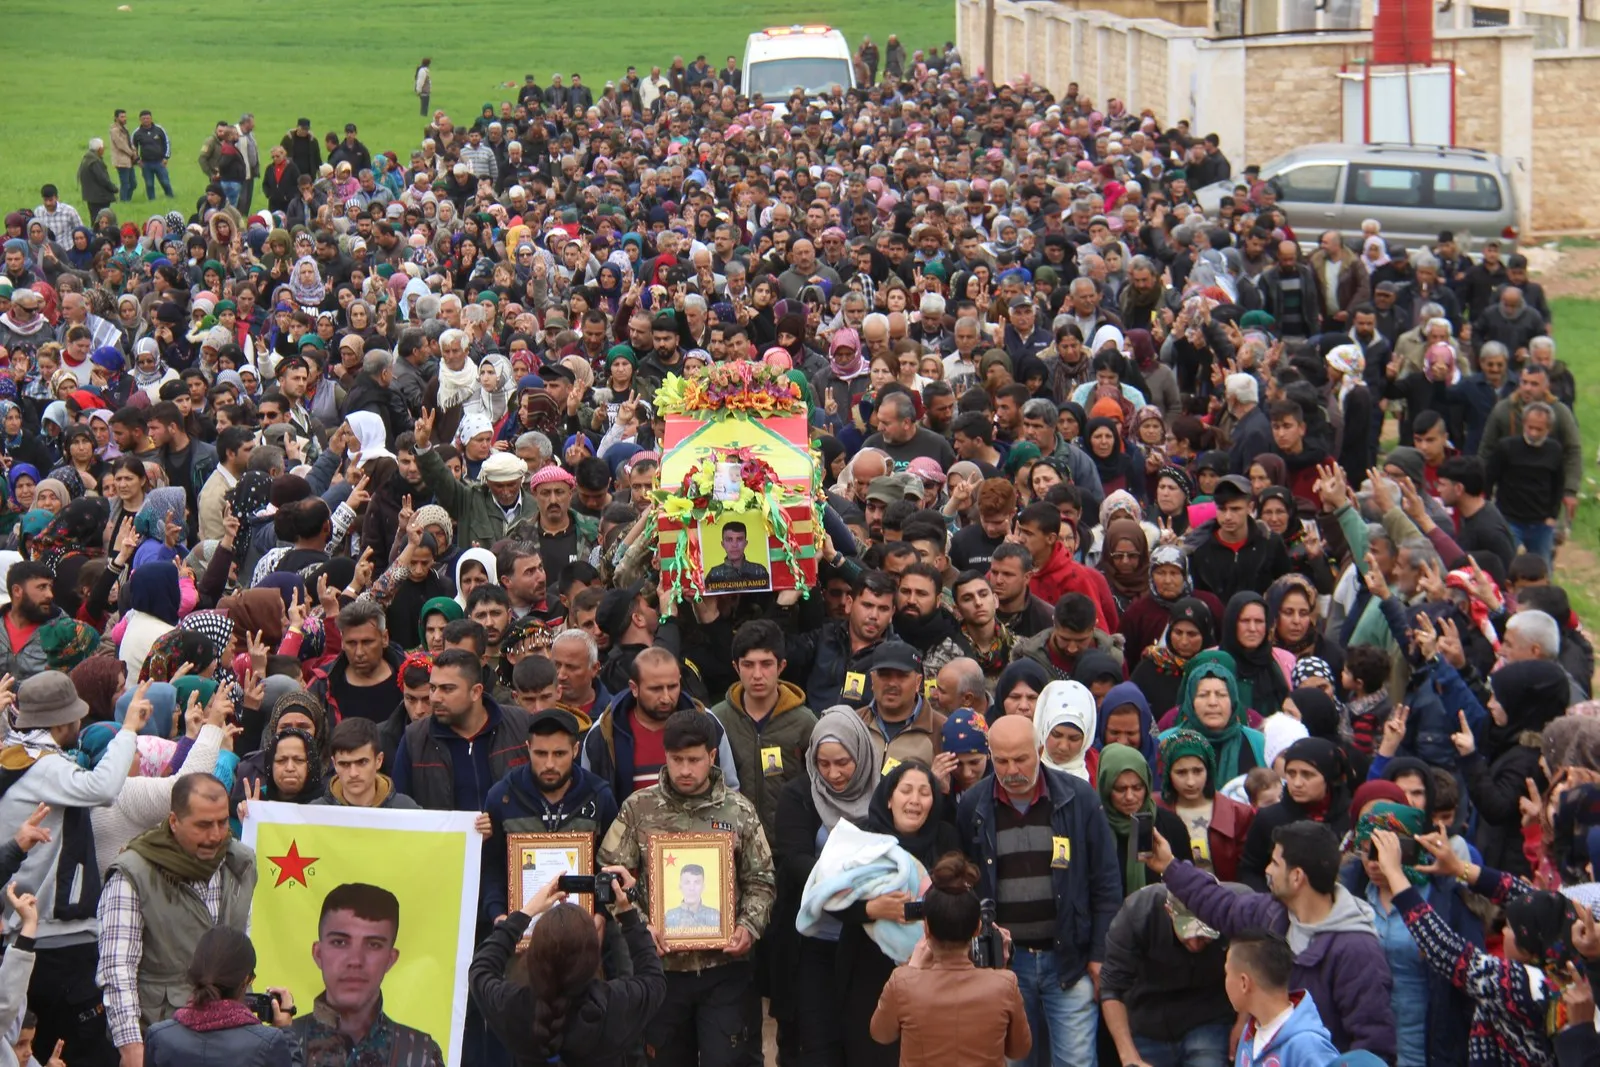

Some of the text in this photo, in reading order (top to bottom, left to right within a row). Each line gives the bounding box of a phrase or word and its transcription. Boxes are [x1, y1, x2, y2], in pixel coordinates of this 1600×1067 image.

[270, 867, 277, 876] Y
[307, 867, 316, 876] G
[288, 880, 296, 889] P
